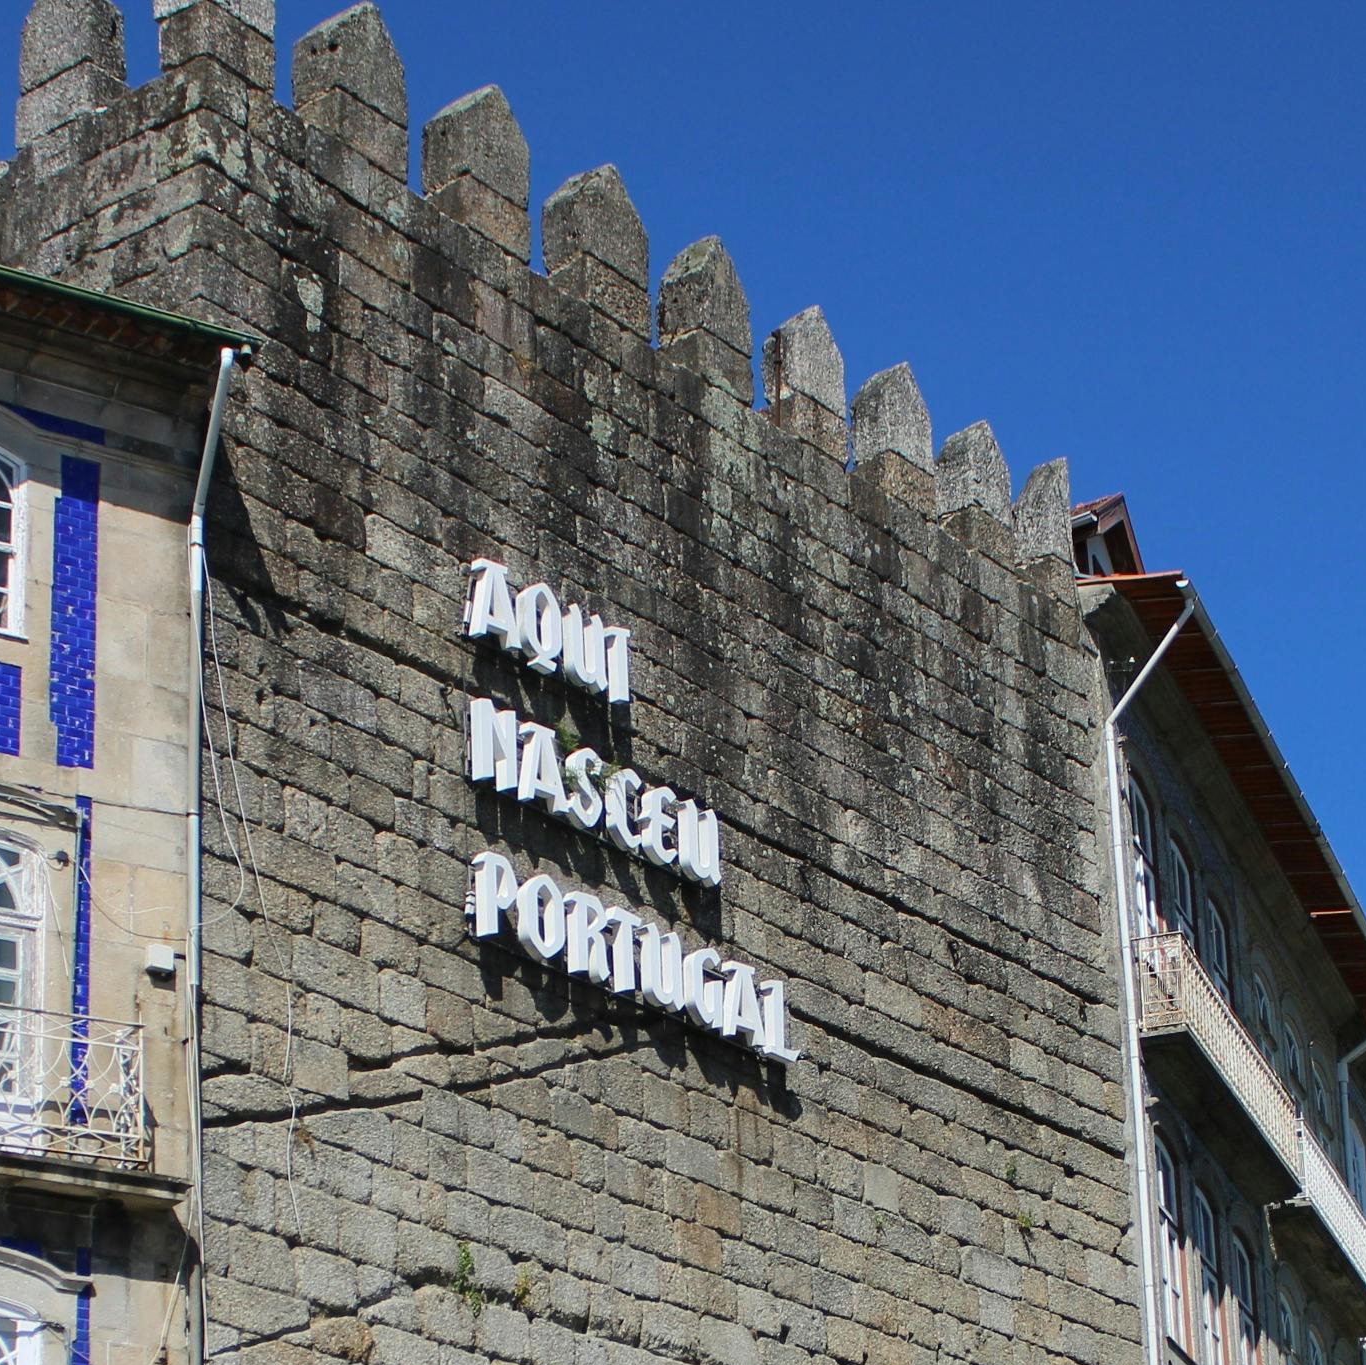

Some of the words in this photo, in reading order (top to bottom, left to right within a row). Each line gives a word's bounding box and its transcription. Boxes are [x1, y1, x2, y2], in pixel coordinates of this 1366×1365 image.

[468, 557, 631, 703] AQUI
[470, 697, 722, 888] NASCEU
[471, 850, 802, 1064] PORTUGAL
